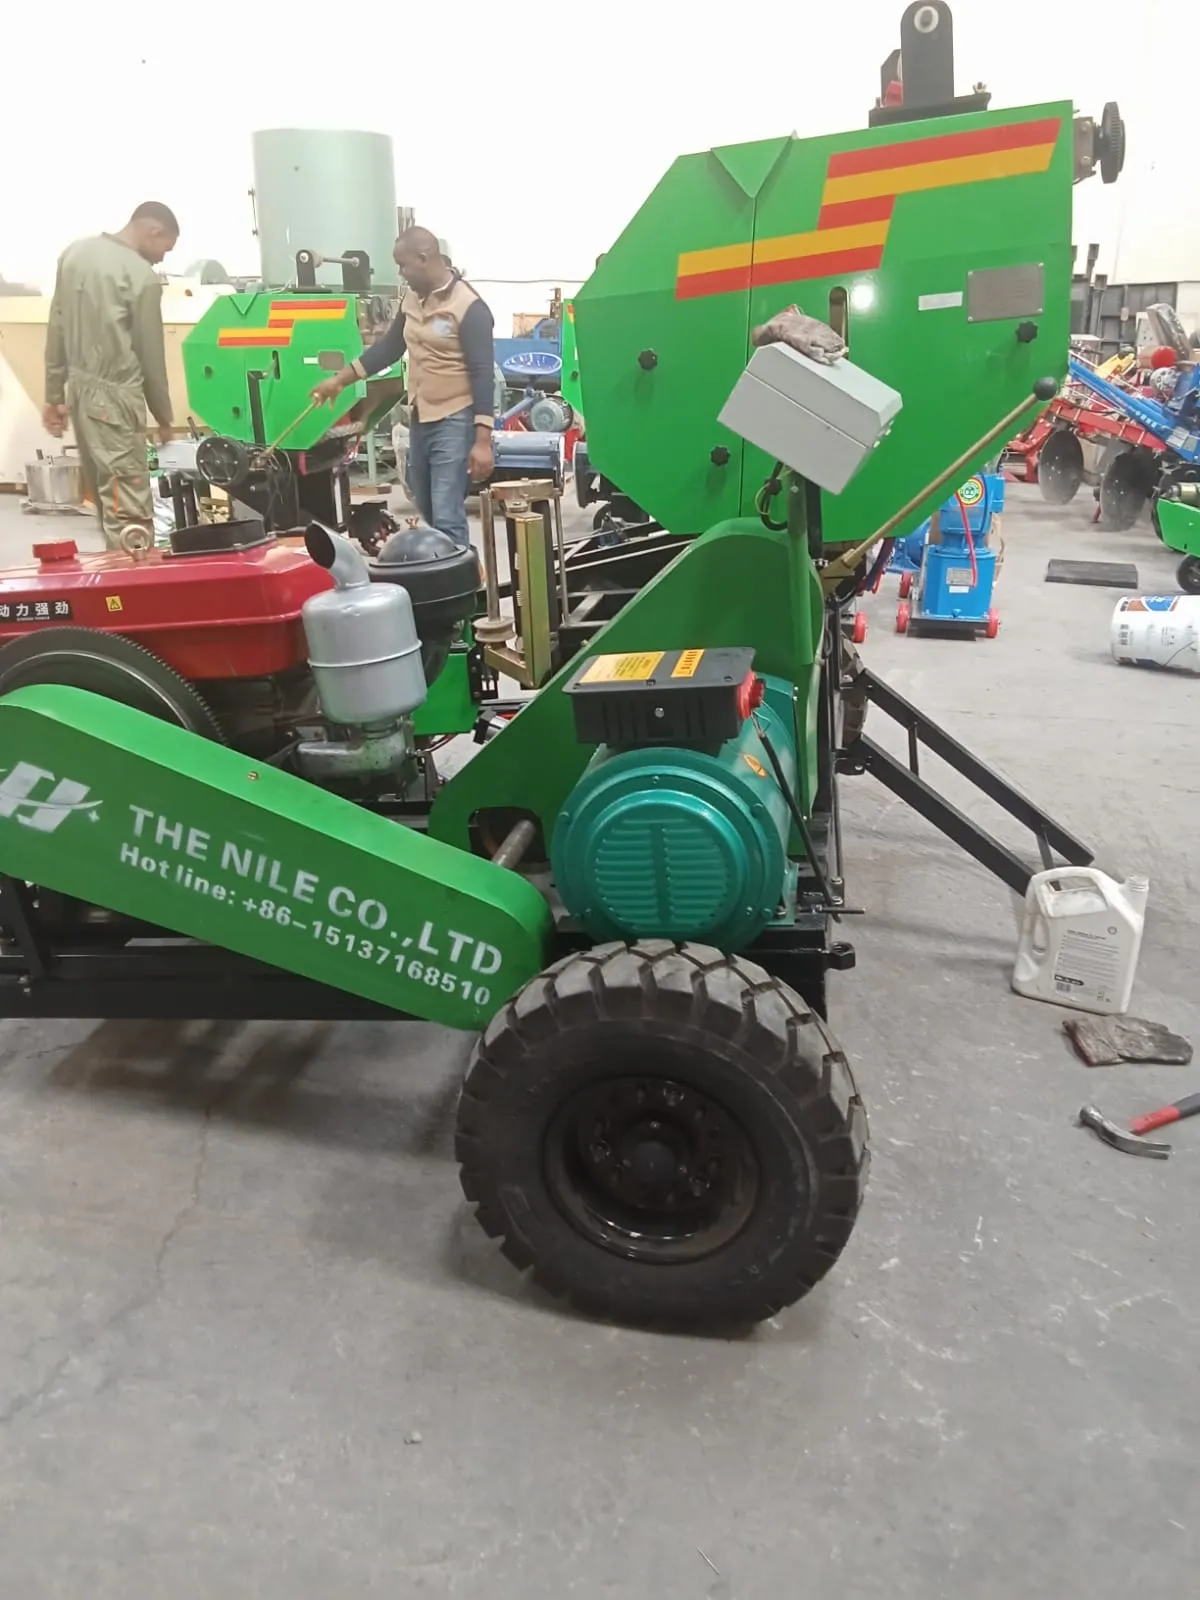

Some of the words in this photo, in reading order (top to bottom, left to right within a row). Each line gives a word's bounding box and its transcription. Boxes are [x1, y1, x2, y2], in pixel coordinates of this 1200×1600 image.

[120, 843, 170, 879] Hot
[176, 864, 236, 907] line:
[129, 804, 210, 861] THE
[221, 841, 319, 904] NILE
